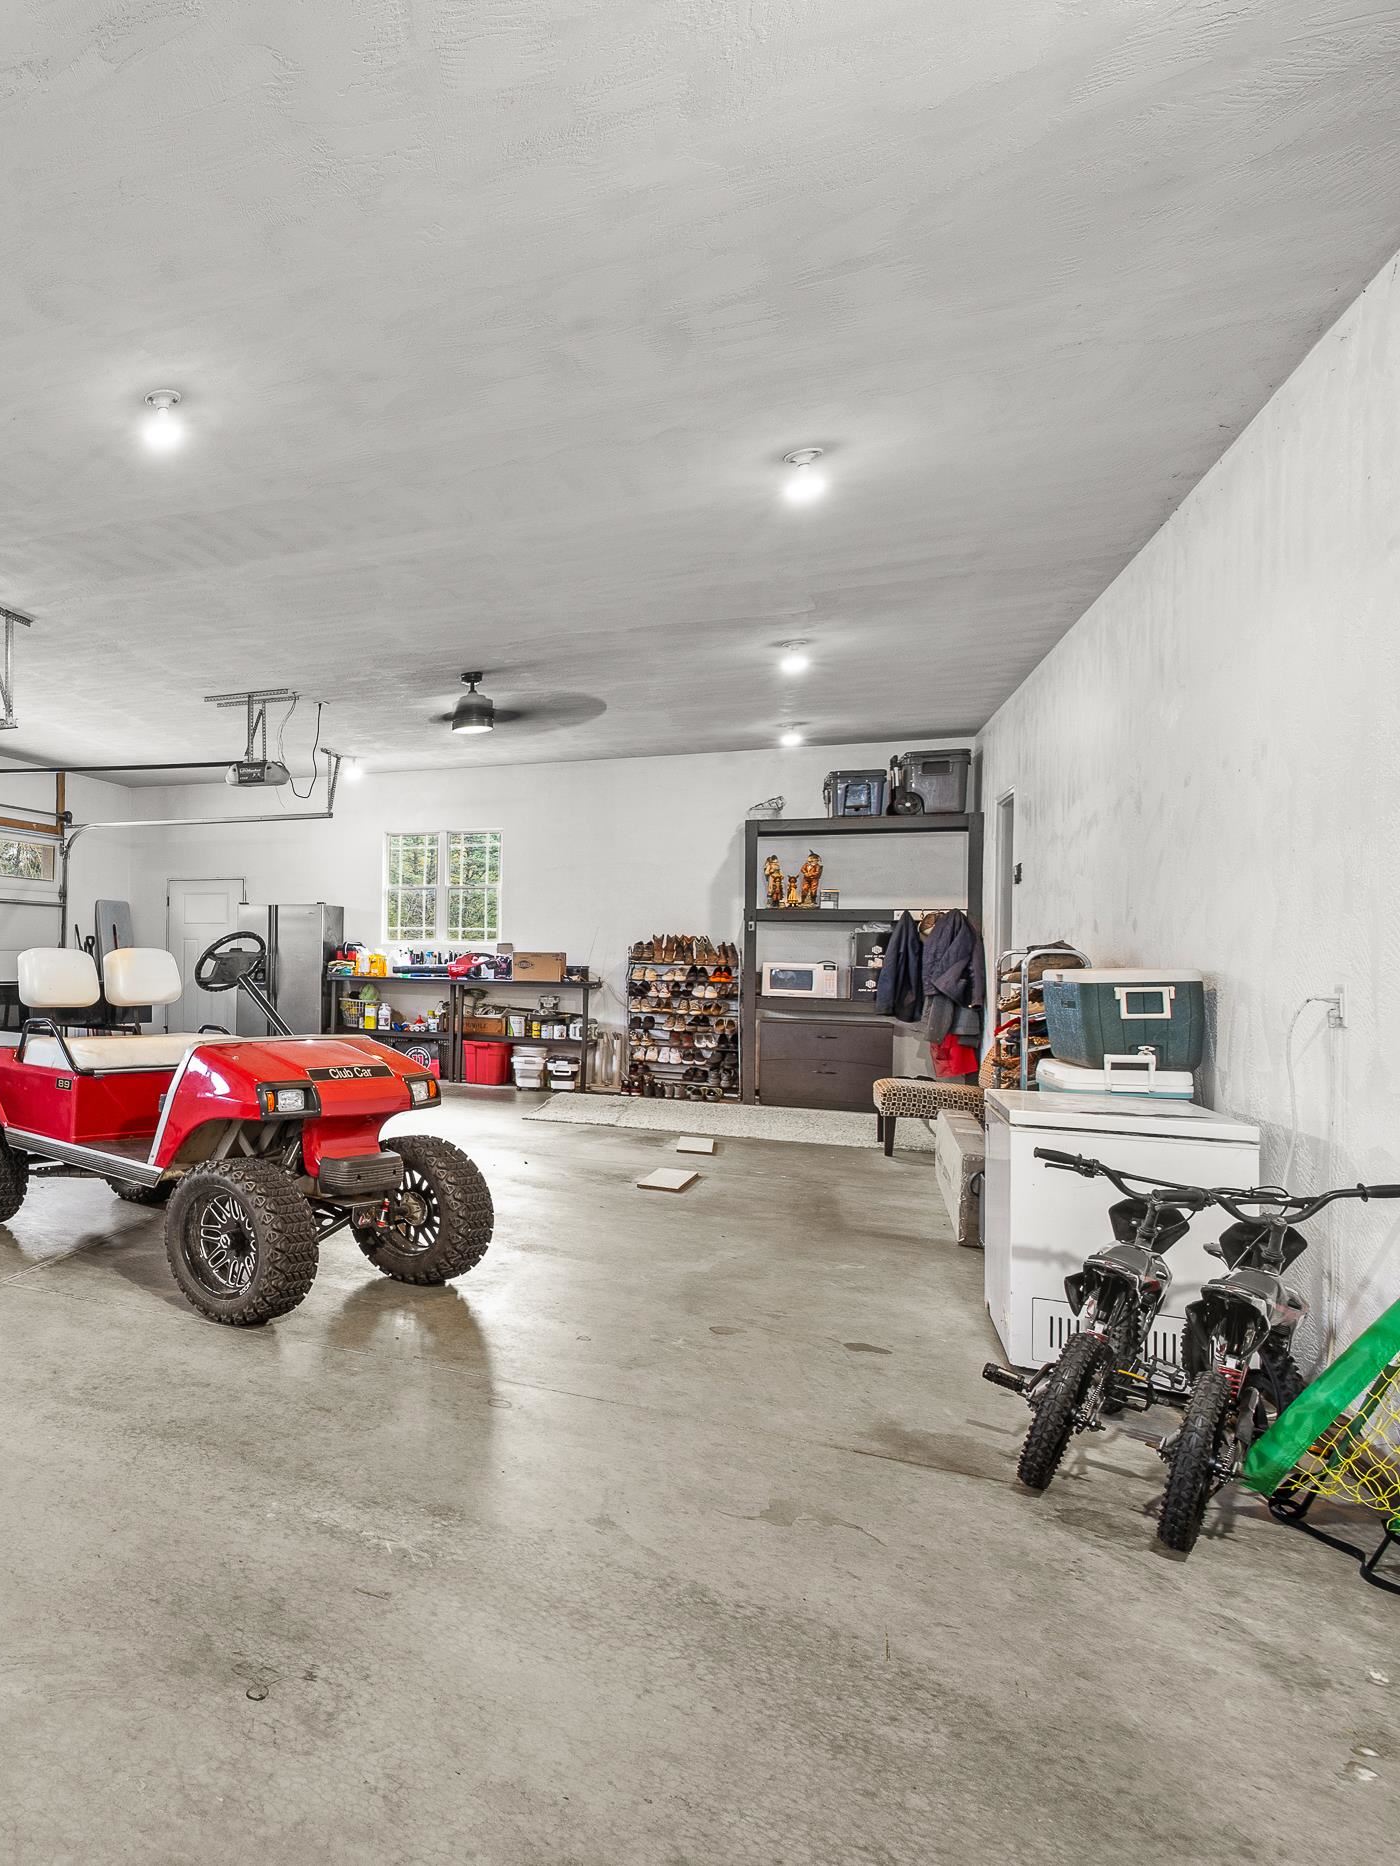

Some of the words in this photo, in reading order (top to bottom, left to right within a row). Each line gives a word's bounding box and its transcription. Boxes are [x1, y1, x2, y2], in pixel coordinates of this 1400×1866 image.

[329, 1068, 354, 1079] Club
[354, 1067, 372, 1077] Car
[58, 1079, 70, 1089] 89
